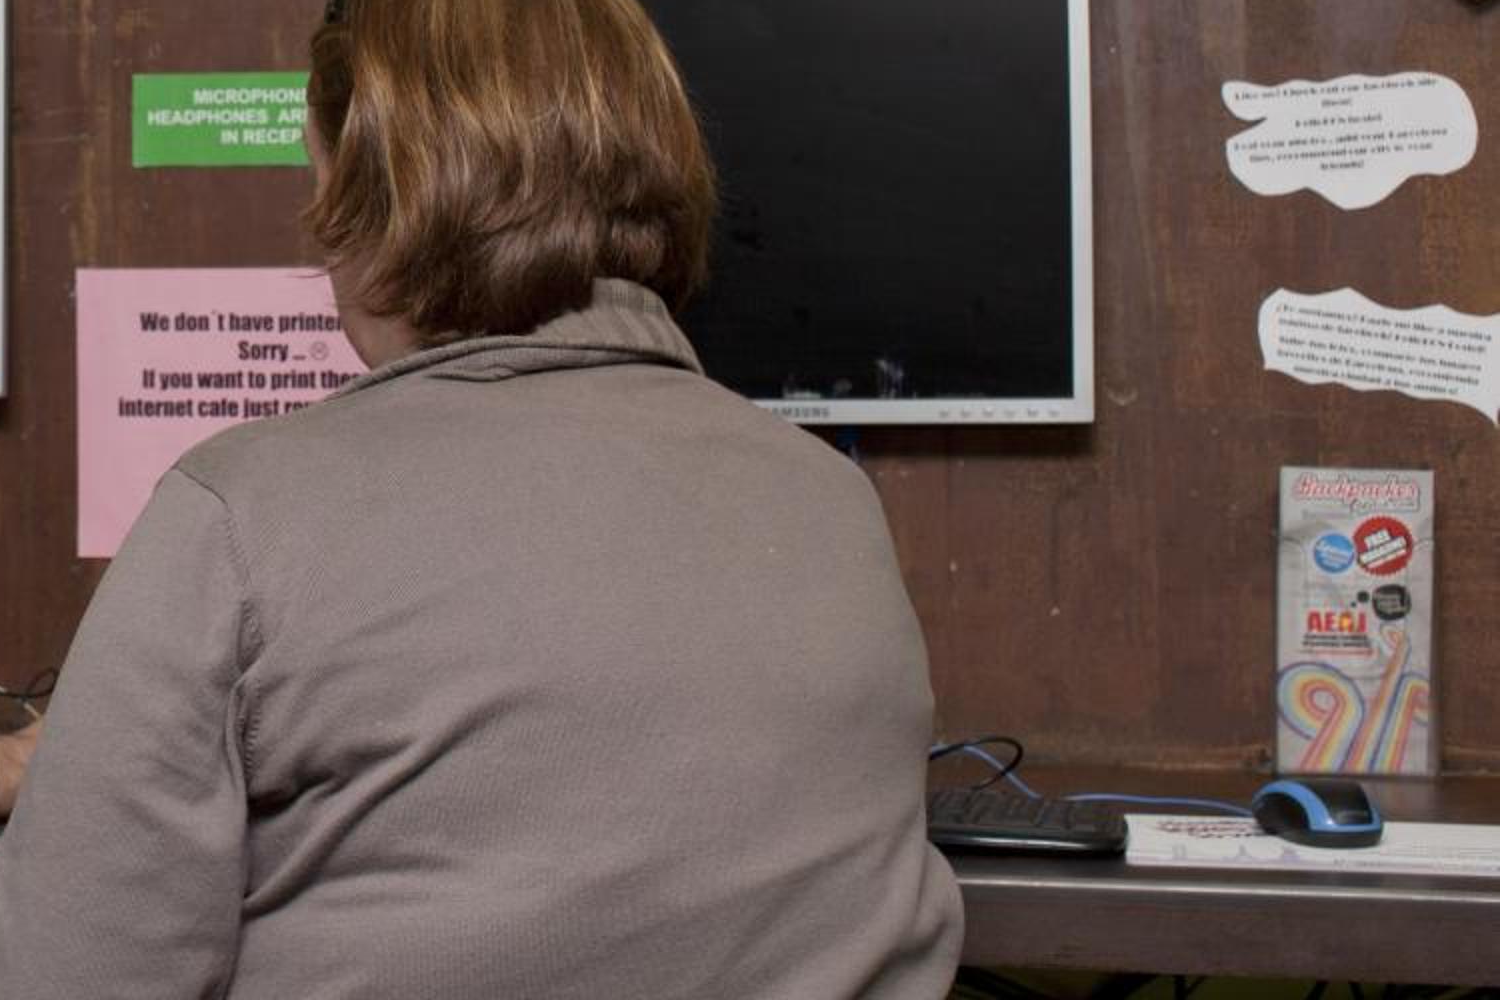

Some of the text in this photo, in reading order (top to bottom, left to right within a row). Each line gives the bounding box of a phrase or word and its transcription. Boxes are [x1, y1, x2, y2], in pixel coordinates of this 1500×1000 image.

[148, 108, 268, 125] HEADPHONES
[221, 128, 302, 145] IN RECEP
[140, 312, 169, 332] We
[229, 312, 274, 332] have
[237, 340, 289, 362] Sorry
[142, 369, 156, 389] If
[160, 372, 192, 391] you
[197, 371, 243, 389] want
[248, 371, 266, 389] to
[271, 368, 316, 391] print
[118, 397, 192, 417] internet
[197, 397, 239, 417] cafe
[243, 398, 279, 419] just
[772, 406, 830, 419] AMSUNG
